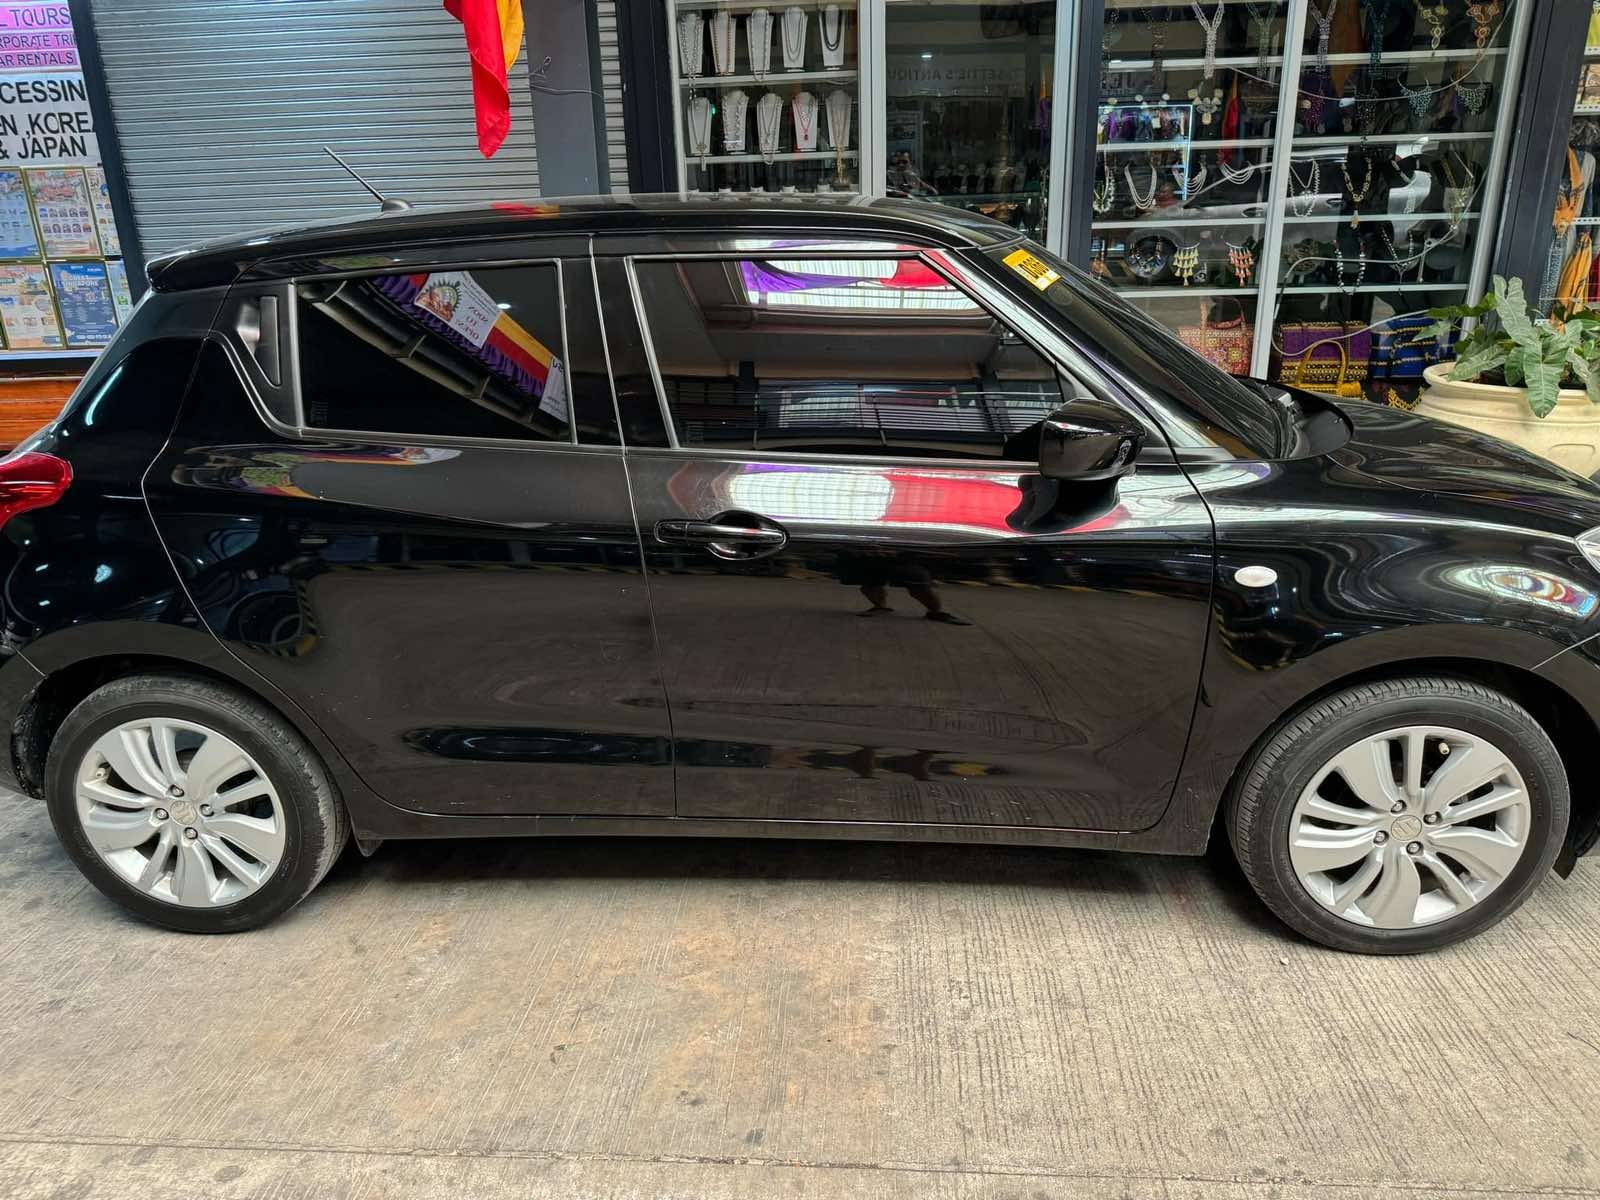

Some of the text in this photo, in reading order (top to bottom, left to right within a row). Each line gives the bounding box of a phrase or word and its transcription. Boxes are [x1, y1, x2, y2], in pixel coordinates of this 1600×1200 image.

[9, 7, 72, 27] TOURS
[17, 52, 74, 66] RENTALS
[0, 79, 87, 104] CESSIN
[17, 135, 87, 159] JAPAN
